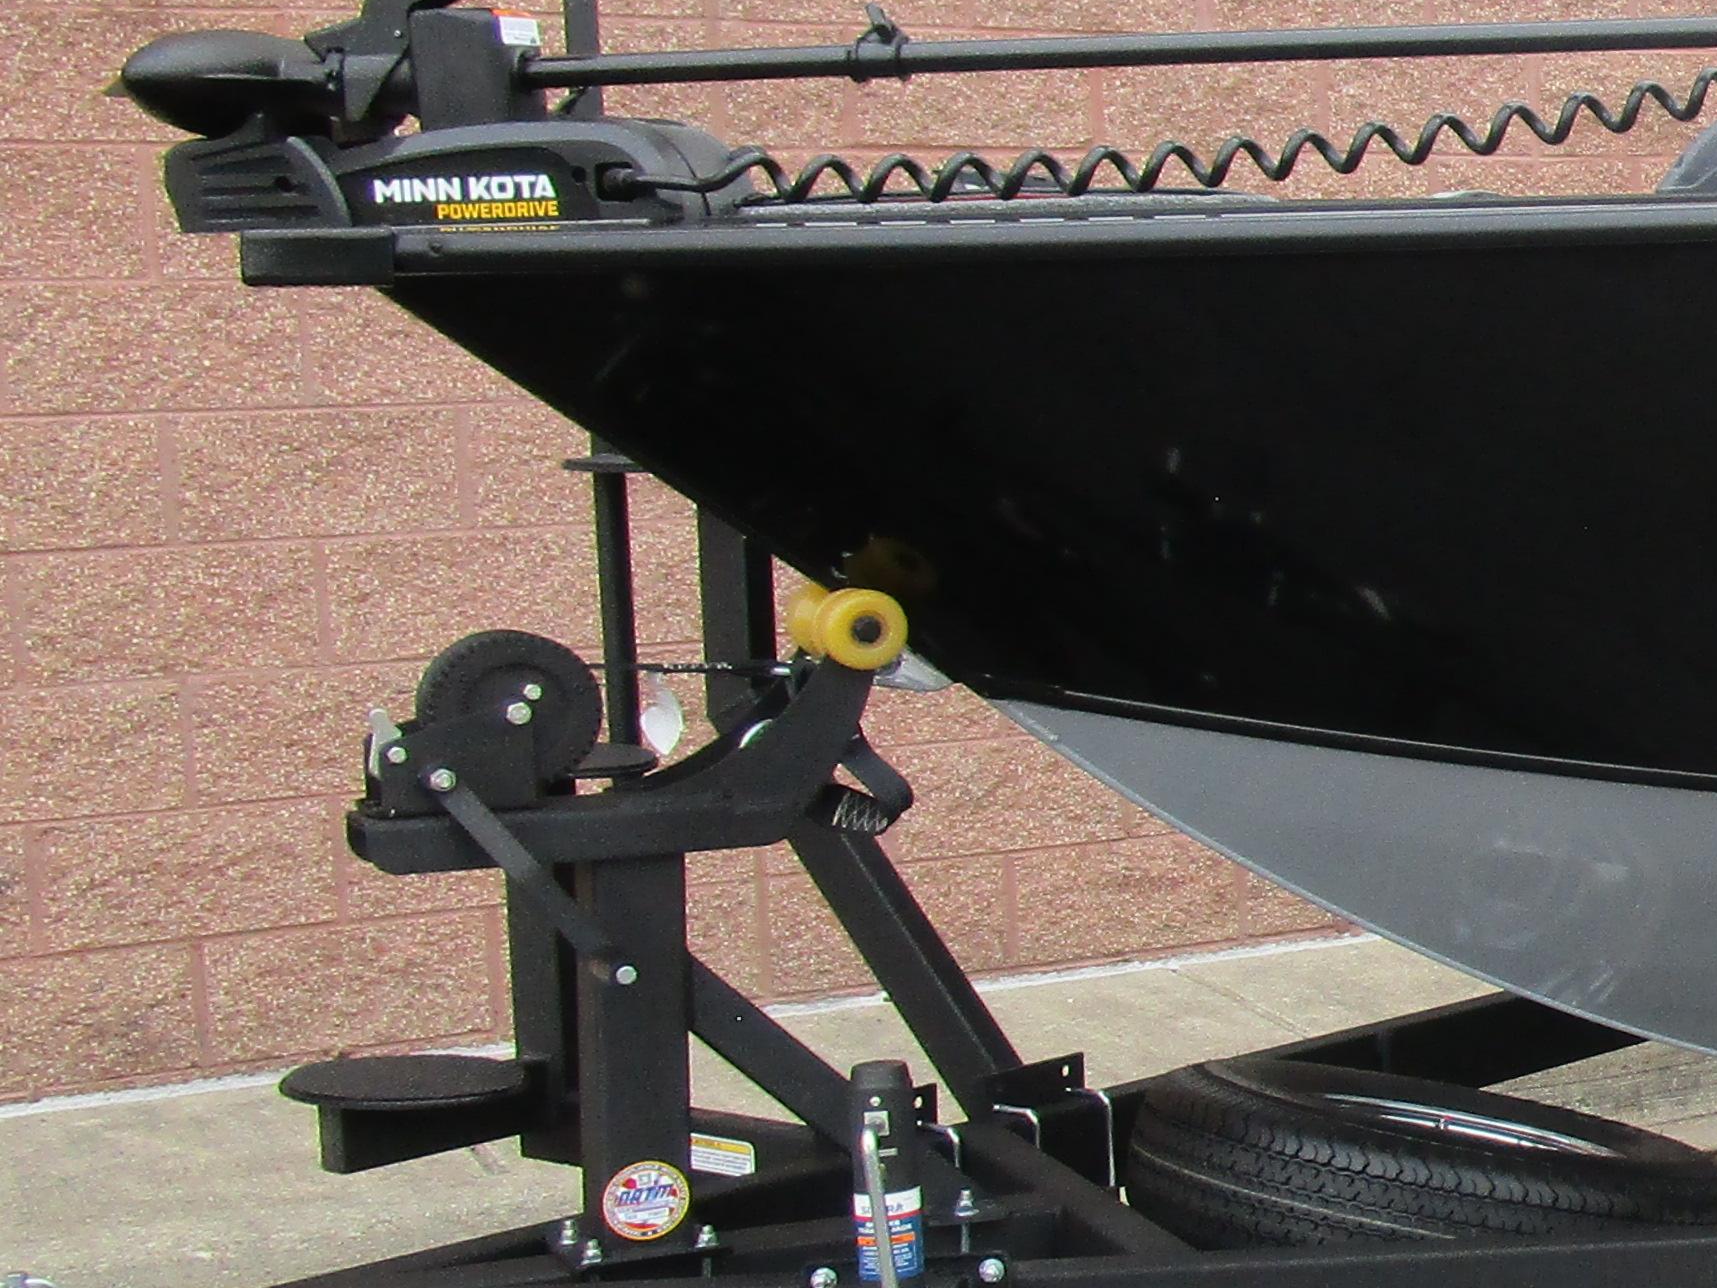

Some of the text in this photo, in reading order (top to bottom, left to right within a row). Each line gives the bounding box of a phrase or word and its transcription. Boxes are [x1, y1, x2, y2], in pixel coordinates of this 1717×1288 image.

[372, 173, 557, 204] MINN KOTA
[436, 200, 560, 220] POWERDRIVE
